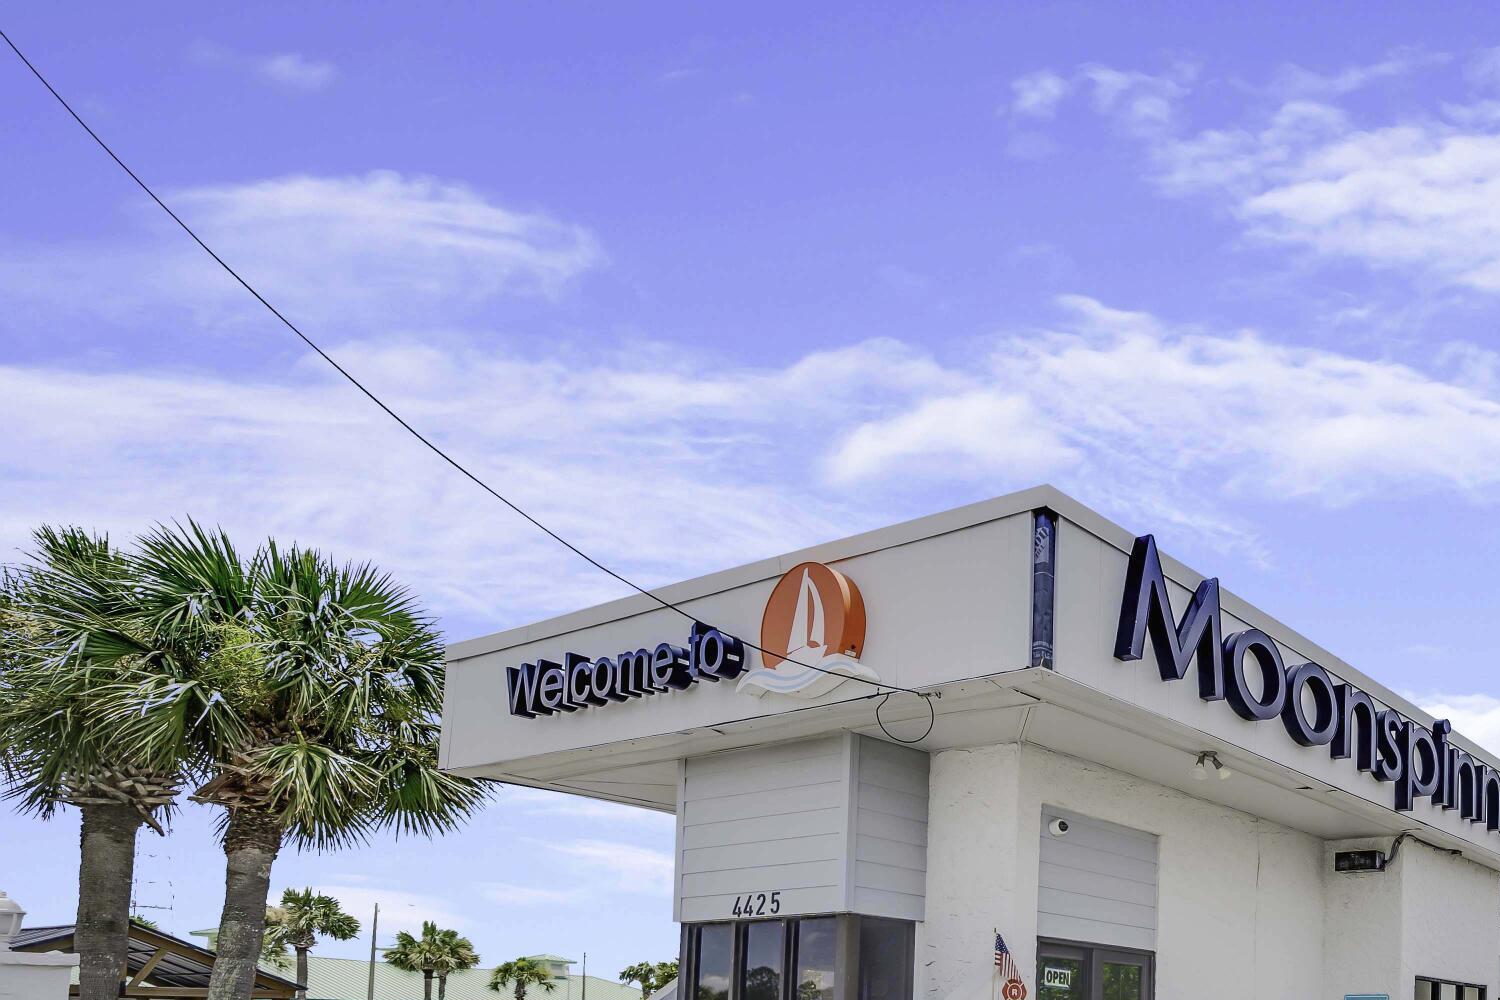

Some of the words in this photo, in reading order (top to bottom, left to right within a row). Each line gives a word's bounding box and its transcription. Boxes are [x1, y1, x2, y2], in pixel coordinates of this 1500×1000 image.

[506, 642, 693, 719] Welcome
[688, 621, 742, 682] to
[732, 891, 781, 918] 4425
[1046, 970, 1070, 986] OPEN
[1011, 988, 1018, 996] R
